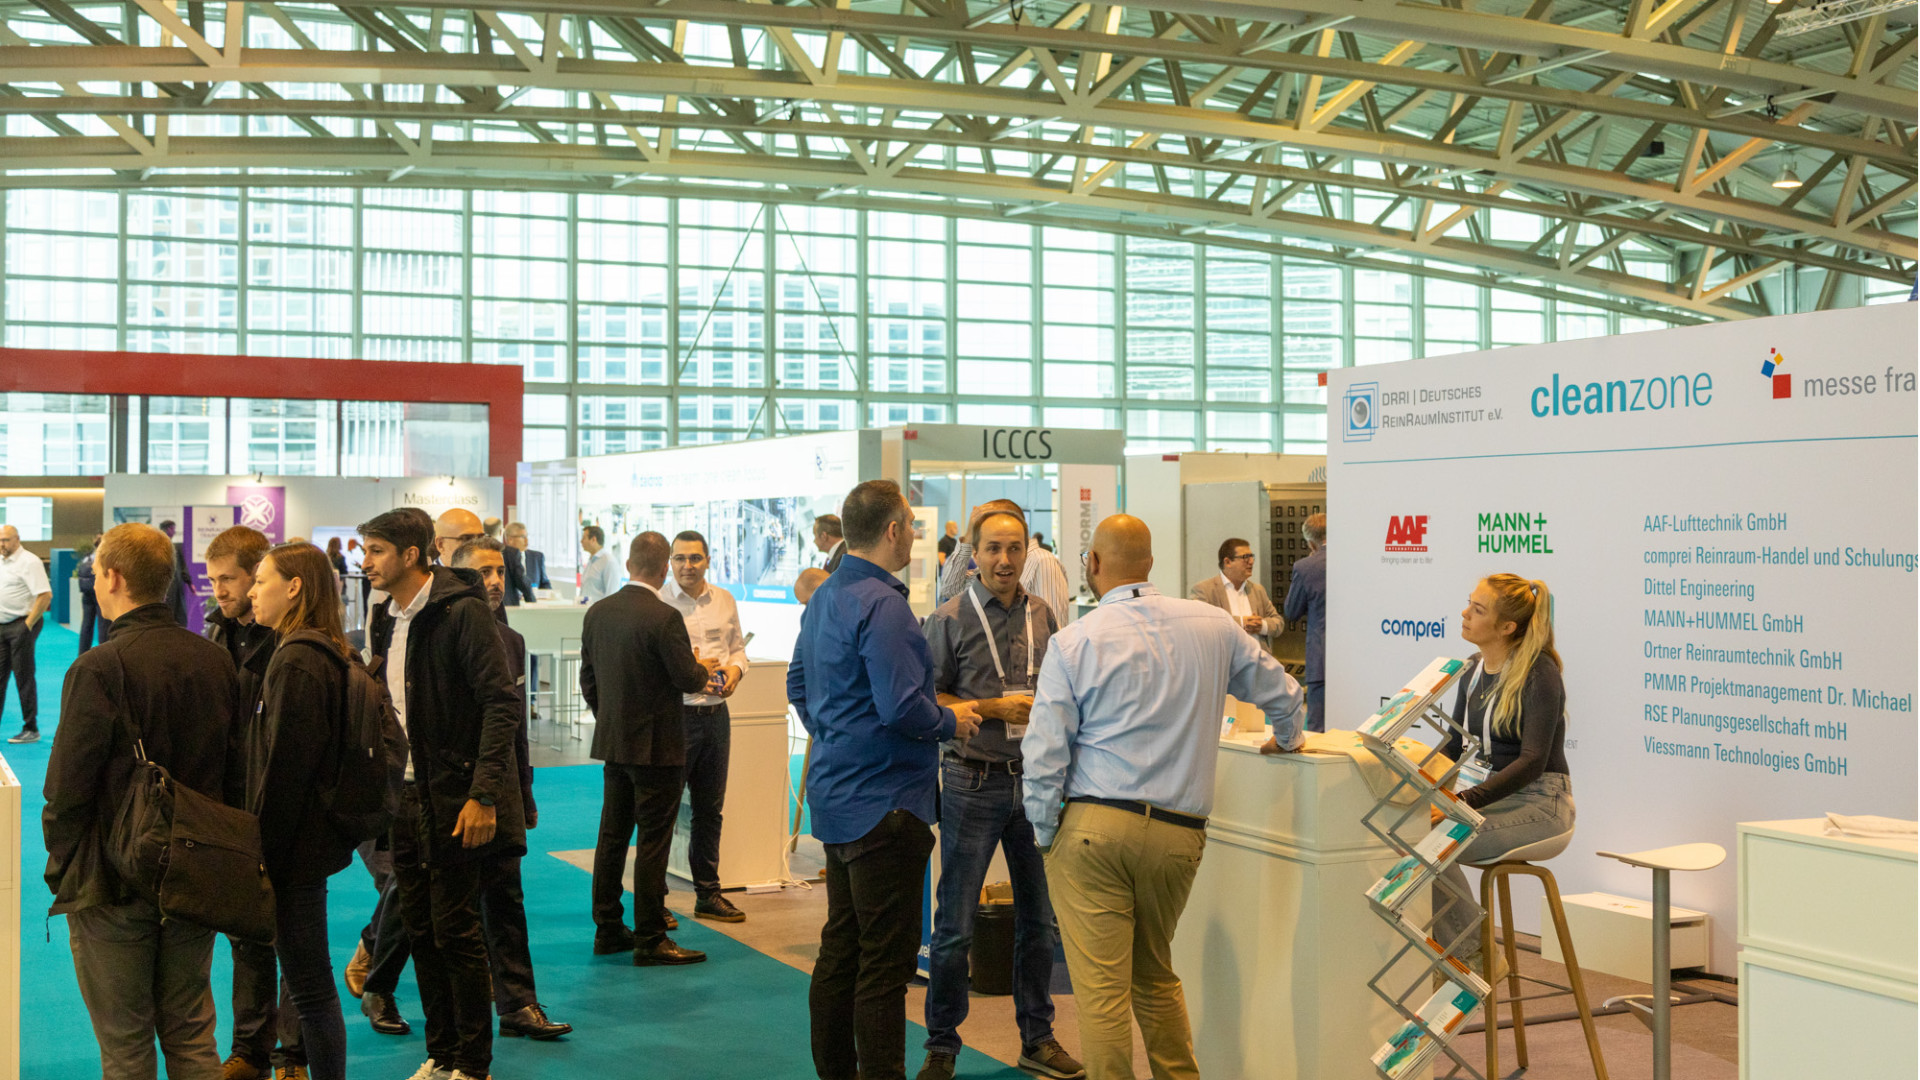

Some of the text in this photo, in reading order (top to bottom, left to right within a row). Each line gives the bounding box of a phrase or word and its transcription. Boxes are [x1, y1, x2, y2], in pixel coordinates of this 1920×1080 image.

[1531, 372, 1713, 418] cleanzone
[1804, 373, 1877, 398] messe
[1382, 391, 1410, 406] DRRI
[1488, 408, 1503, 421] e.V.
[983, 429, 1052, 459] ICCCS
[1385, 515, 1428, 545] AAF
[1478, 512, 1547, 531] MANN+
[1644, 512, 1787, 532] AAF-Lufttechnik GmbH
[1478, 534, 1553, 553] HUMMEL
[1644, 547, 1692, 568] comprei
[1696, 546, 1809, 565] Reinraum-Handel
[1813, 547, 1840, 566] und
[1644, 577, 1755, 602] Dittel Engineering
[1381, 617, 1445, 642] comprei
[1644, 609, 1804, 633] MANN+HUMMEL GmbH
[1644, 640, 1842, 671] Ortner Reinraumtechnik GmbH
[1644, 672, 1912, 712] PMMR Projektmanagement Dr. Michael
[1644, 704, 1847, 741] RSE Planungsgesellschaft mbH
[1644, 735, 1847, 776] Viessmann Technologies GmbH
